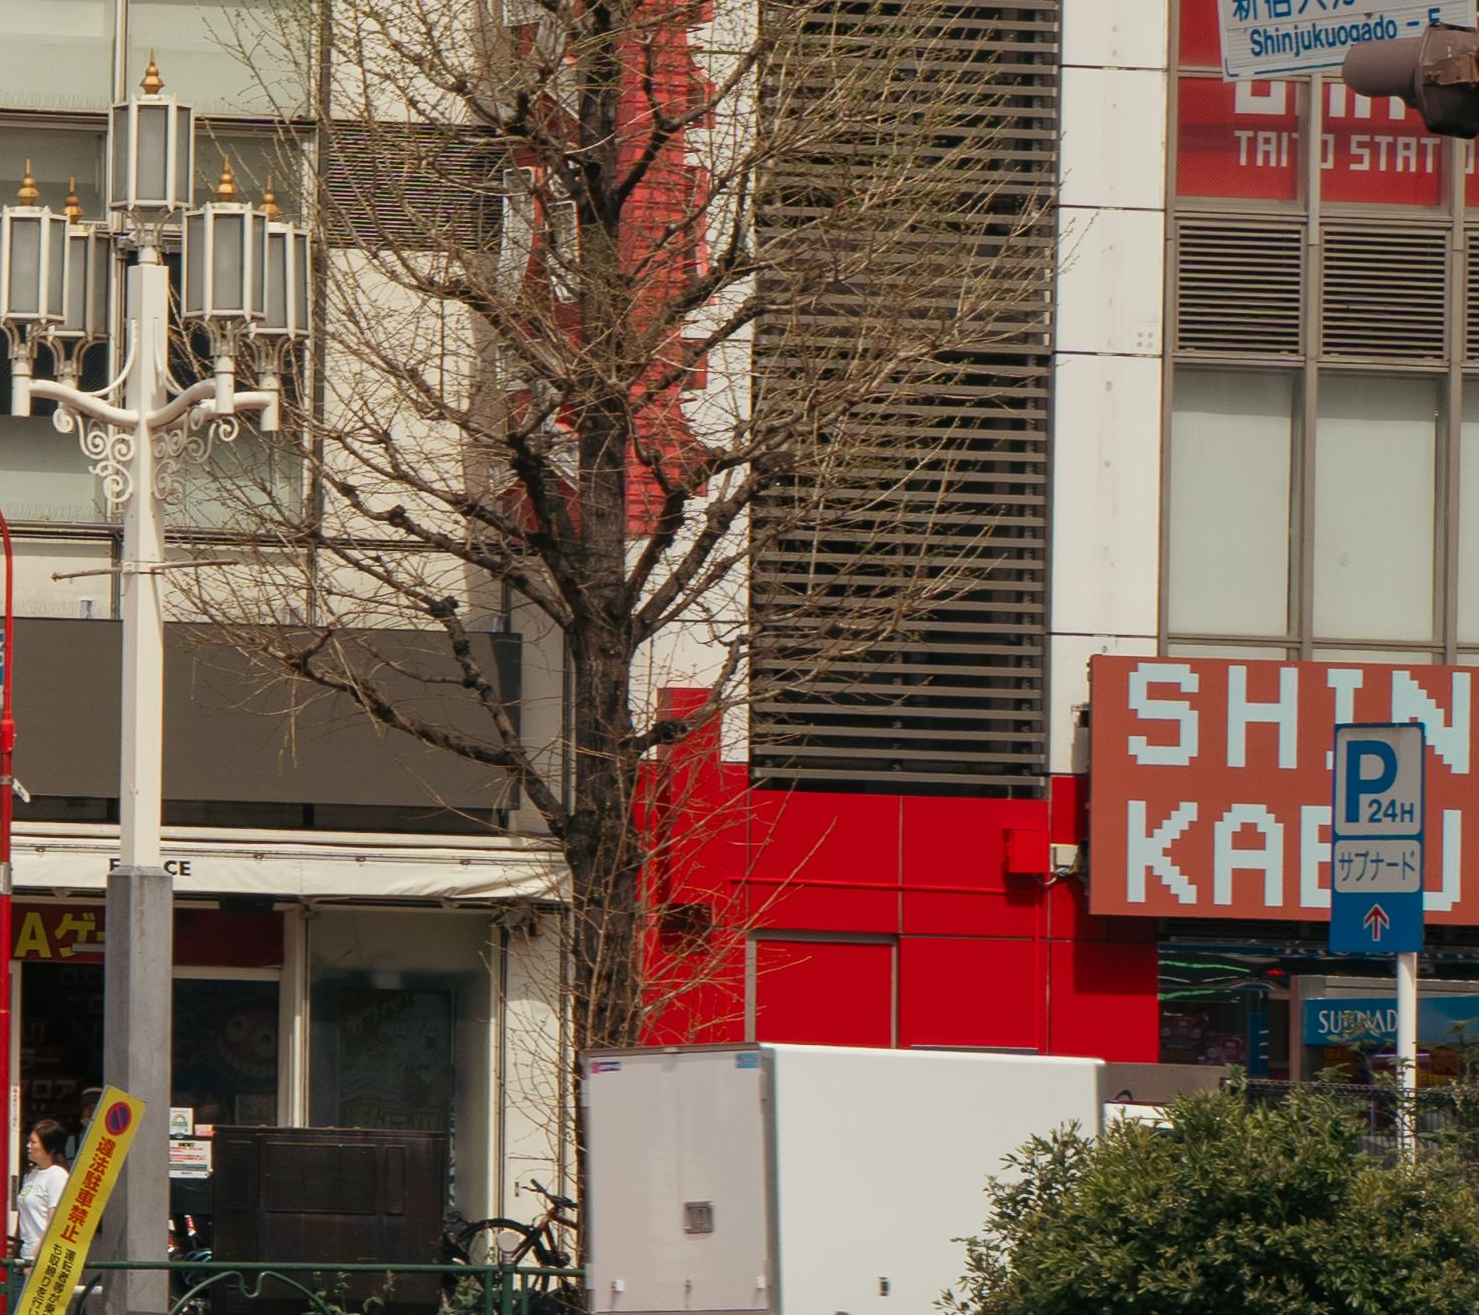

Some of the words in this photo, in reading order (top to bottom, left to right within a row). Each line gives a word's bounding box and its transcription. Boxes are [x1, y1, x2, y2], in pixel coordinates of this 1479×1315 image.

[1345, 740, 1397, 824] P
[1368, 800, 1414, 823] 24H
[1337, 851, 1416, 882] サブナード
[60, 1137, 116, 1244] 違法駐車禁止
